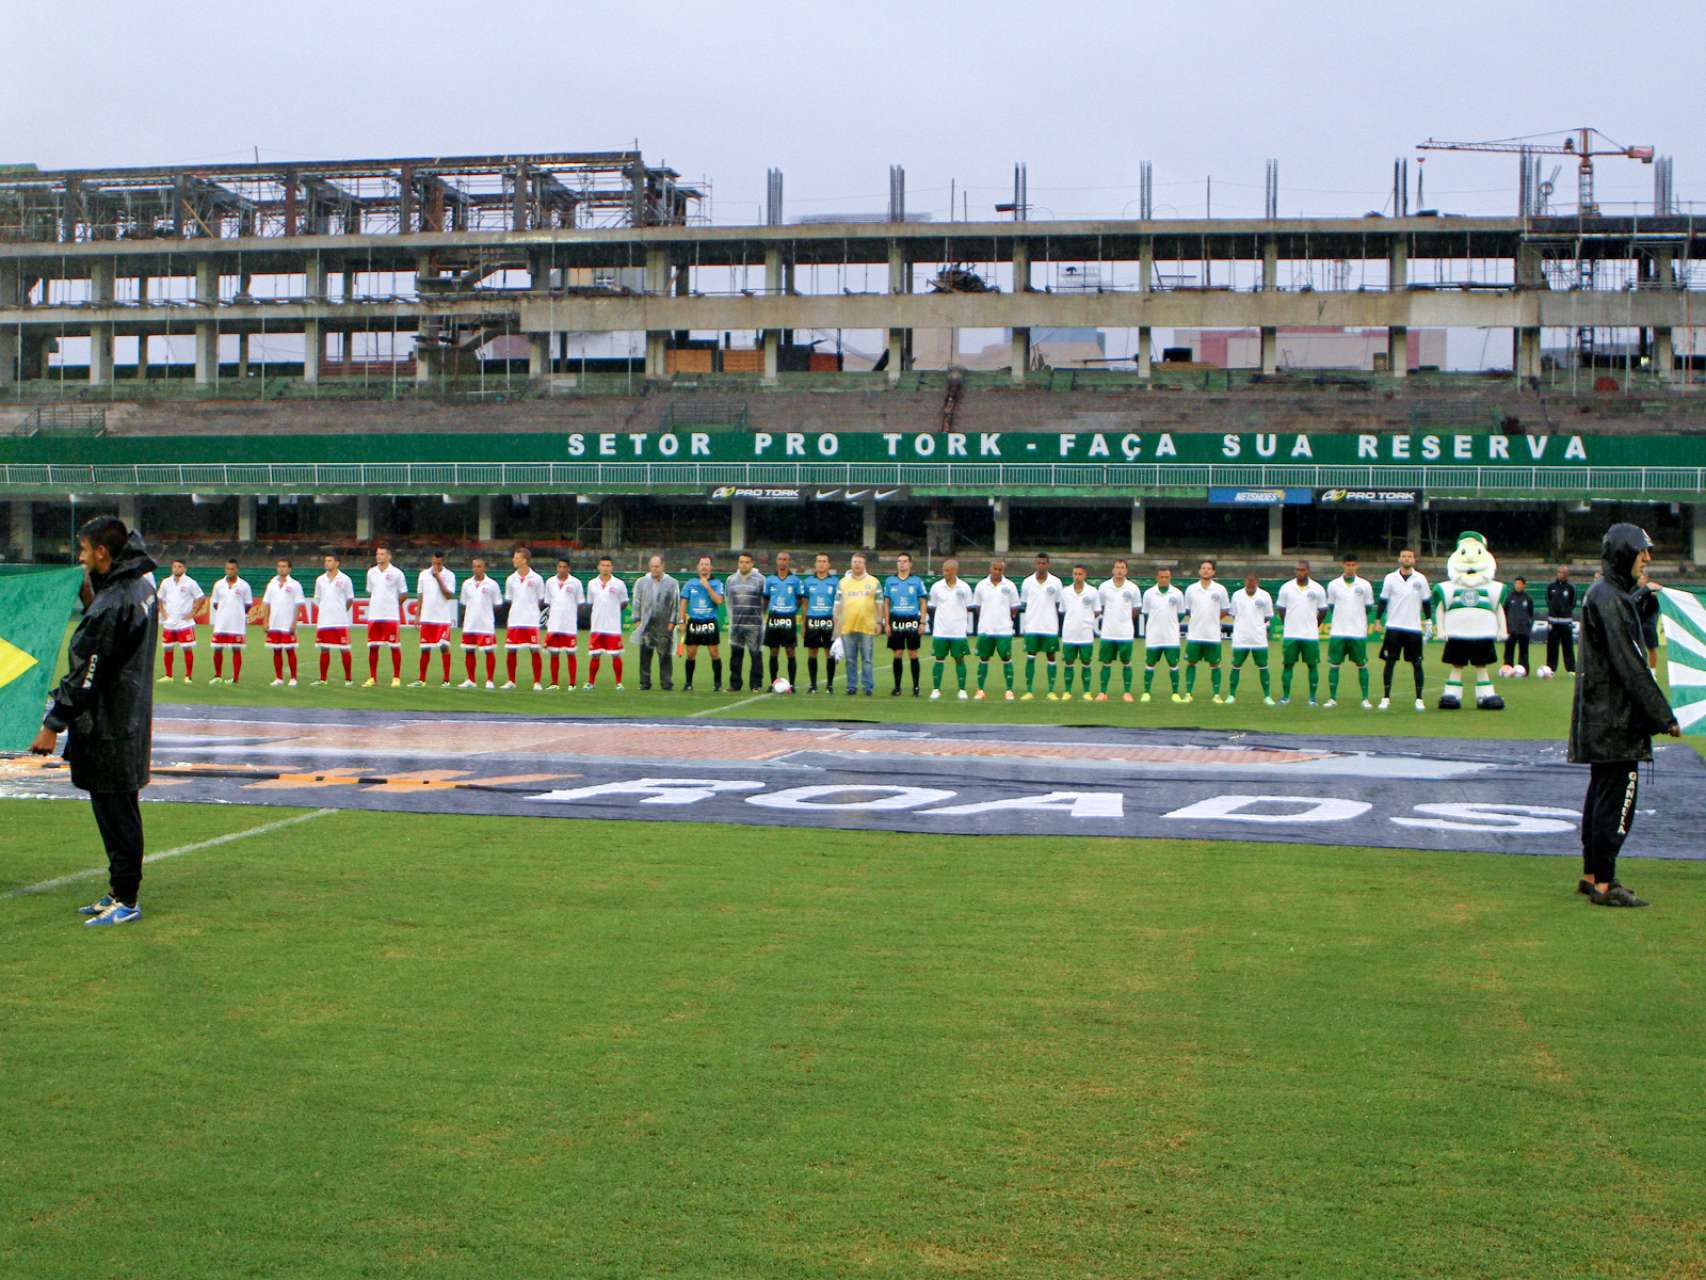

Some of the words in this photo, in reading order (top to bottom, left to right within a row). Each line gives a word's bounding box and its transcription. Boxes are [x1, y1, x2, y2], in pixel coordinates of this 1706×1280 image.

[568, 432, 710, 455] SETOR
[754, 432, 838, 455] PRO
[883, 432, 1001, 456] TORK
[1059, 433, 1177, 461] FAÇA
[1221, 433, 1313, 458] SUA
[1358, 434, 1587, 459] RESERVA
[735, 488, 763, 497] PRO
[765, 488, 800, 497] TORK
[1345, 491, 1373, 500] PRO
[1373, 491, 1416, 500] TORK
[689, 622, 715, 632] LUPO
[768, 618, 792, 627] LUPO
[808, 618, 833, 628] LUPO
[892, 620, 919, 630] LUPO
[523, 778, 1583, 833] ROADS
